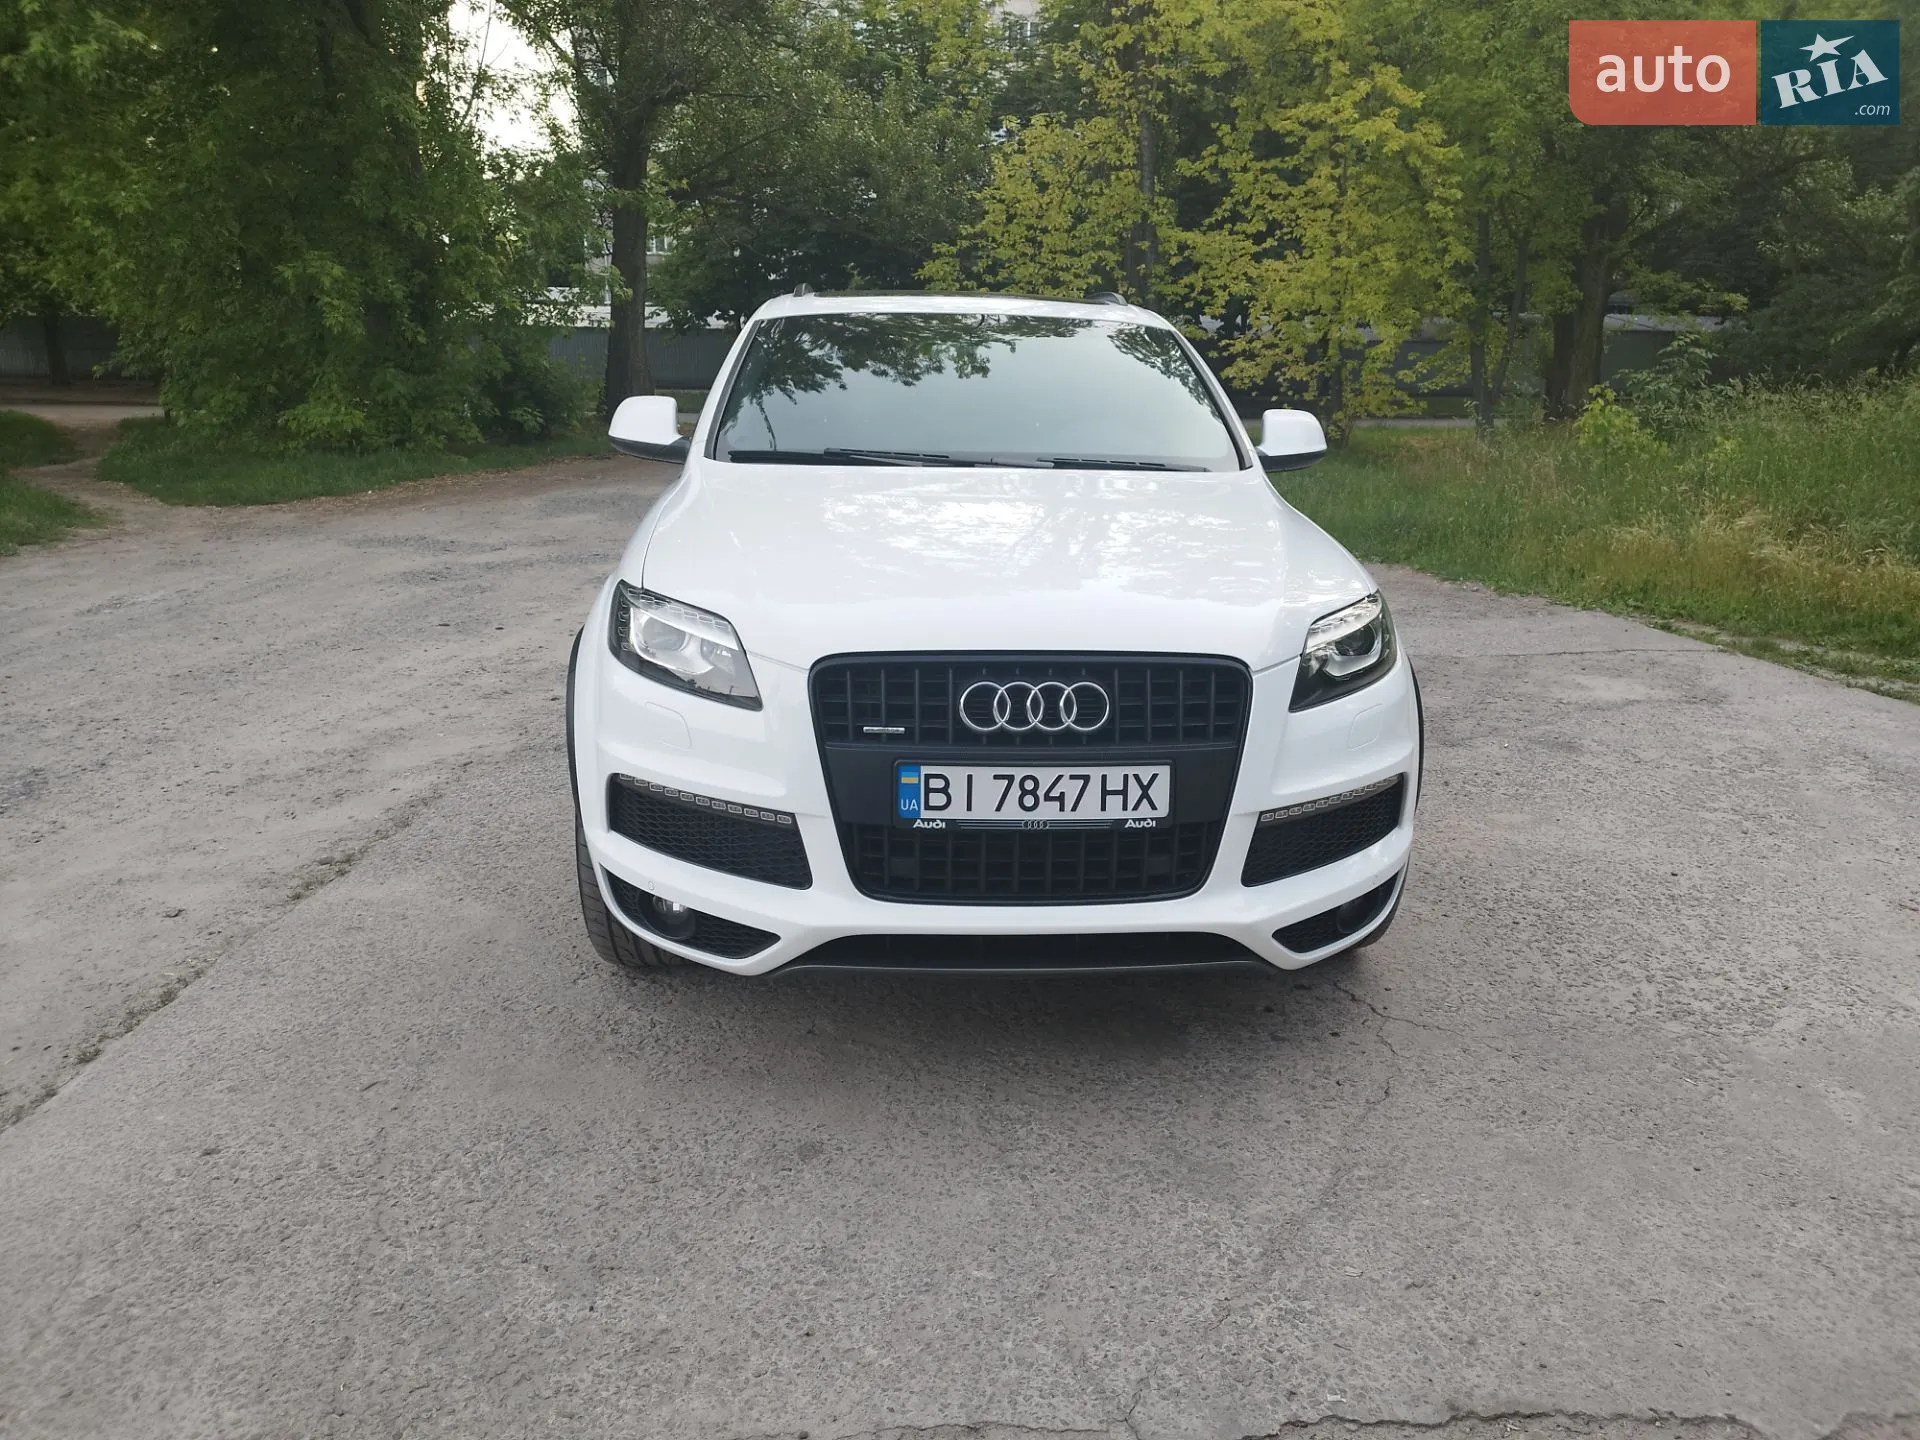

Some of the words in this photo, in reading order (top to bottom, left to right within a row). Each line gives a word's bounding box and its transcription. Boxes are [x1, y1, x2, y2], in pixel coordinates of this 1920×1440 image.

[900, 798, 919, 811] UA
[912, 818, 947, 829] Audi
[1124, 818, 1157, 829] Audi
